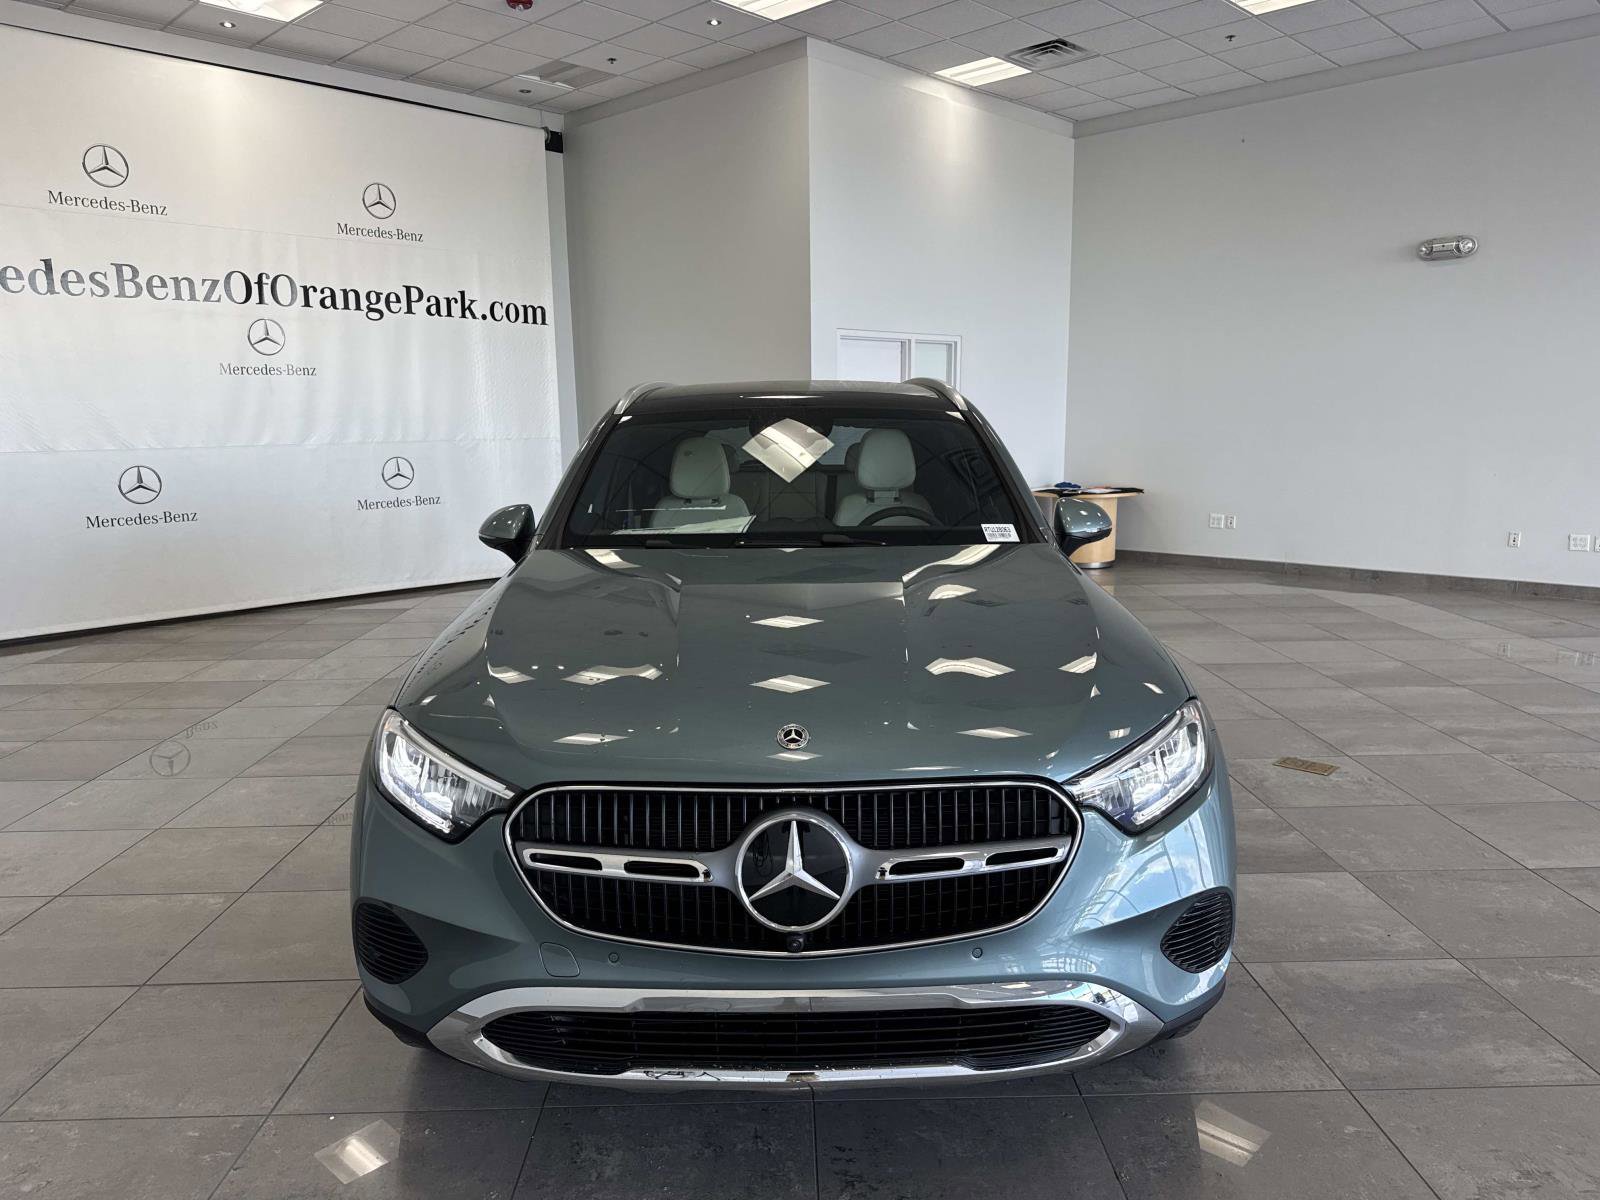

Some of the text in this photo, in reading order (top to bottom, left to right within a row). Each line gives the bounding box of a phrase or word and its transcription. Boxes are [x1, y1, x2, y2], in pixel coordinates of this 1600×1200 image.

[48, 190, 168, 216] Mercedes-Benz
[336, 222, 424, 243] Mercedes-Benz
[219, 362, 317, 377] Mercedes-Benz
[357, 495, 441, 511] Mercedes-Benz
[85, 511, 198, 528] Mercedes-Benz
